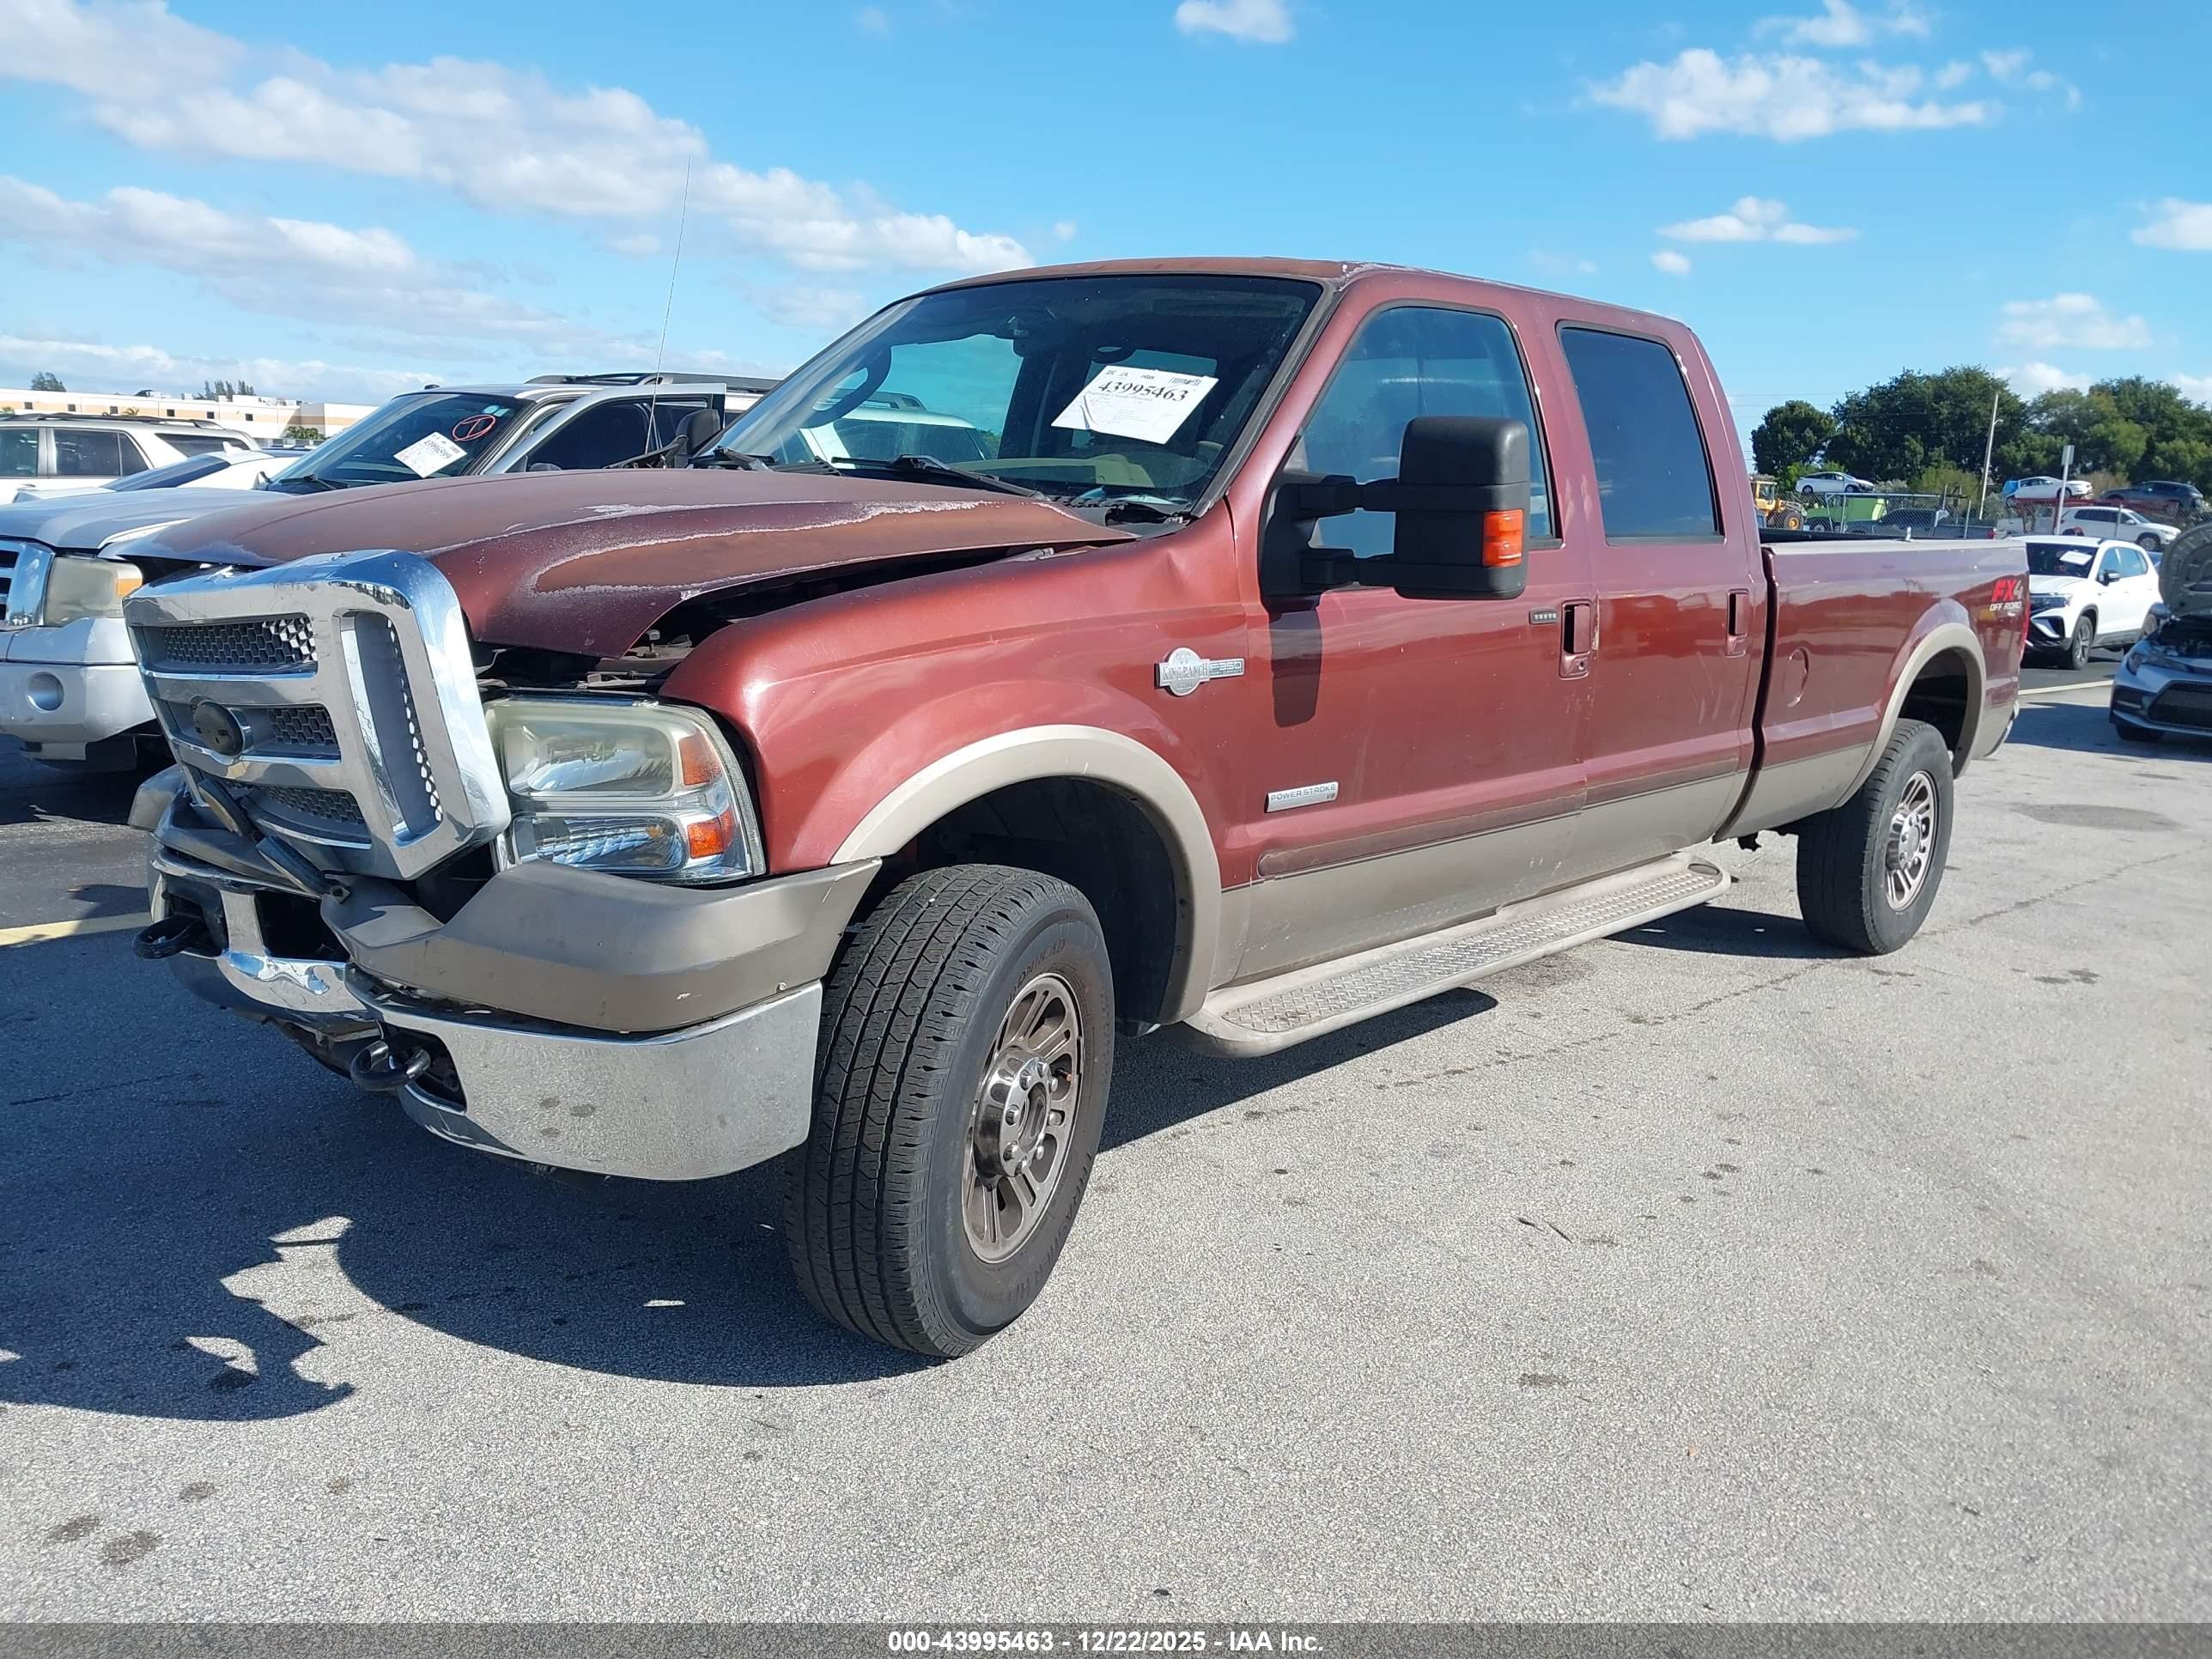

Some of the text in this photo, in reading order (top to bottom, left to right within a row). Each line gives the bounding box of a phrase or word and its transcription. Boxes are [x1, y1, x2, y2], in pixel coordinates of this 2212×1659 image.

[1099, 380, 1188, 402] 43995463
[1991, 580, 2023, 602] FX4
[1990, 601, 2021, 611] OFF ROAD
[1162, 665, 1182, 681] KING
[1182, 662, 1208, 679] RANCH
